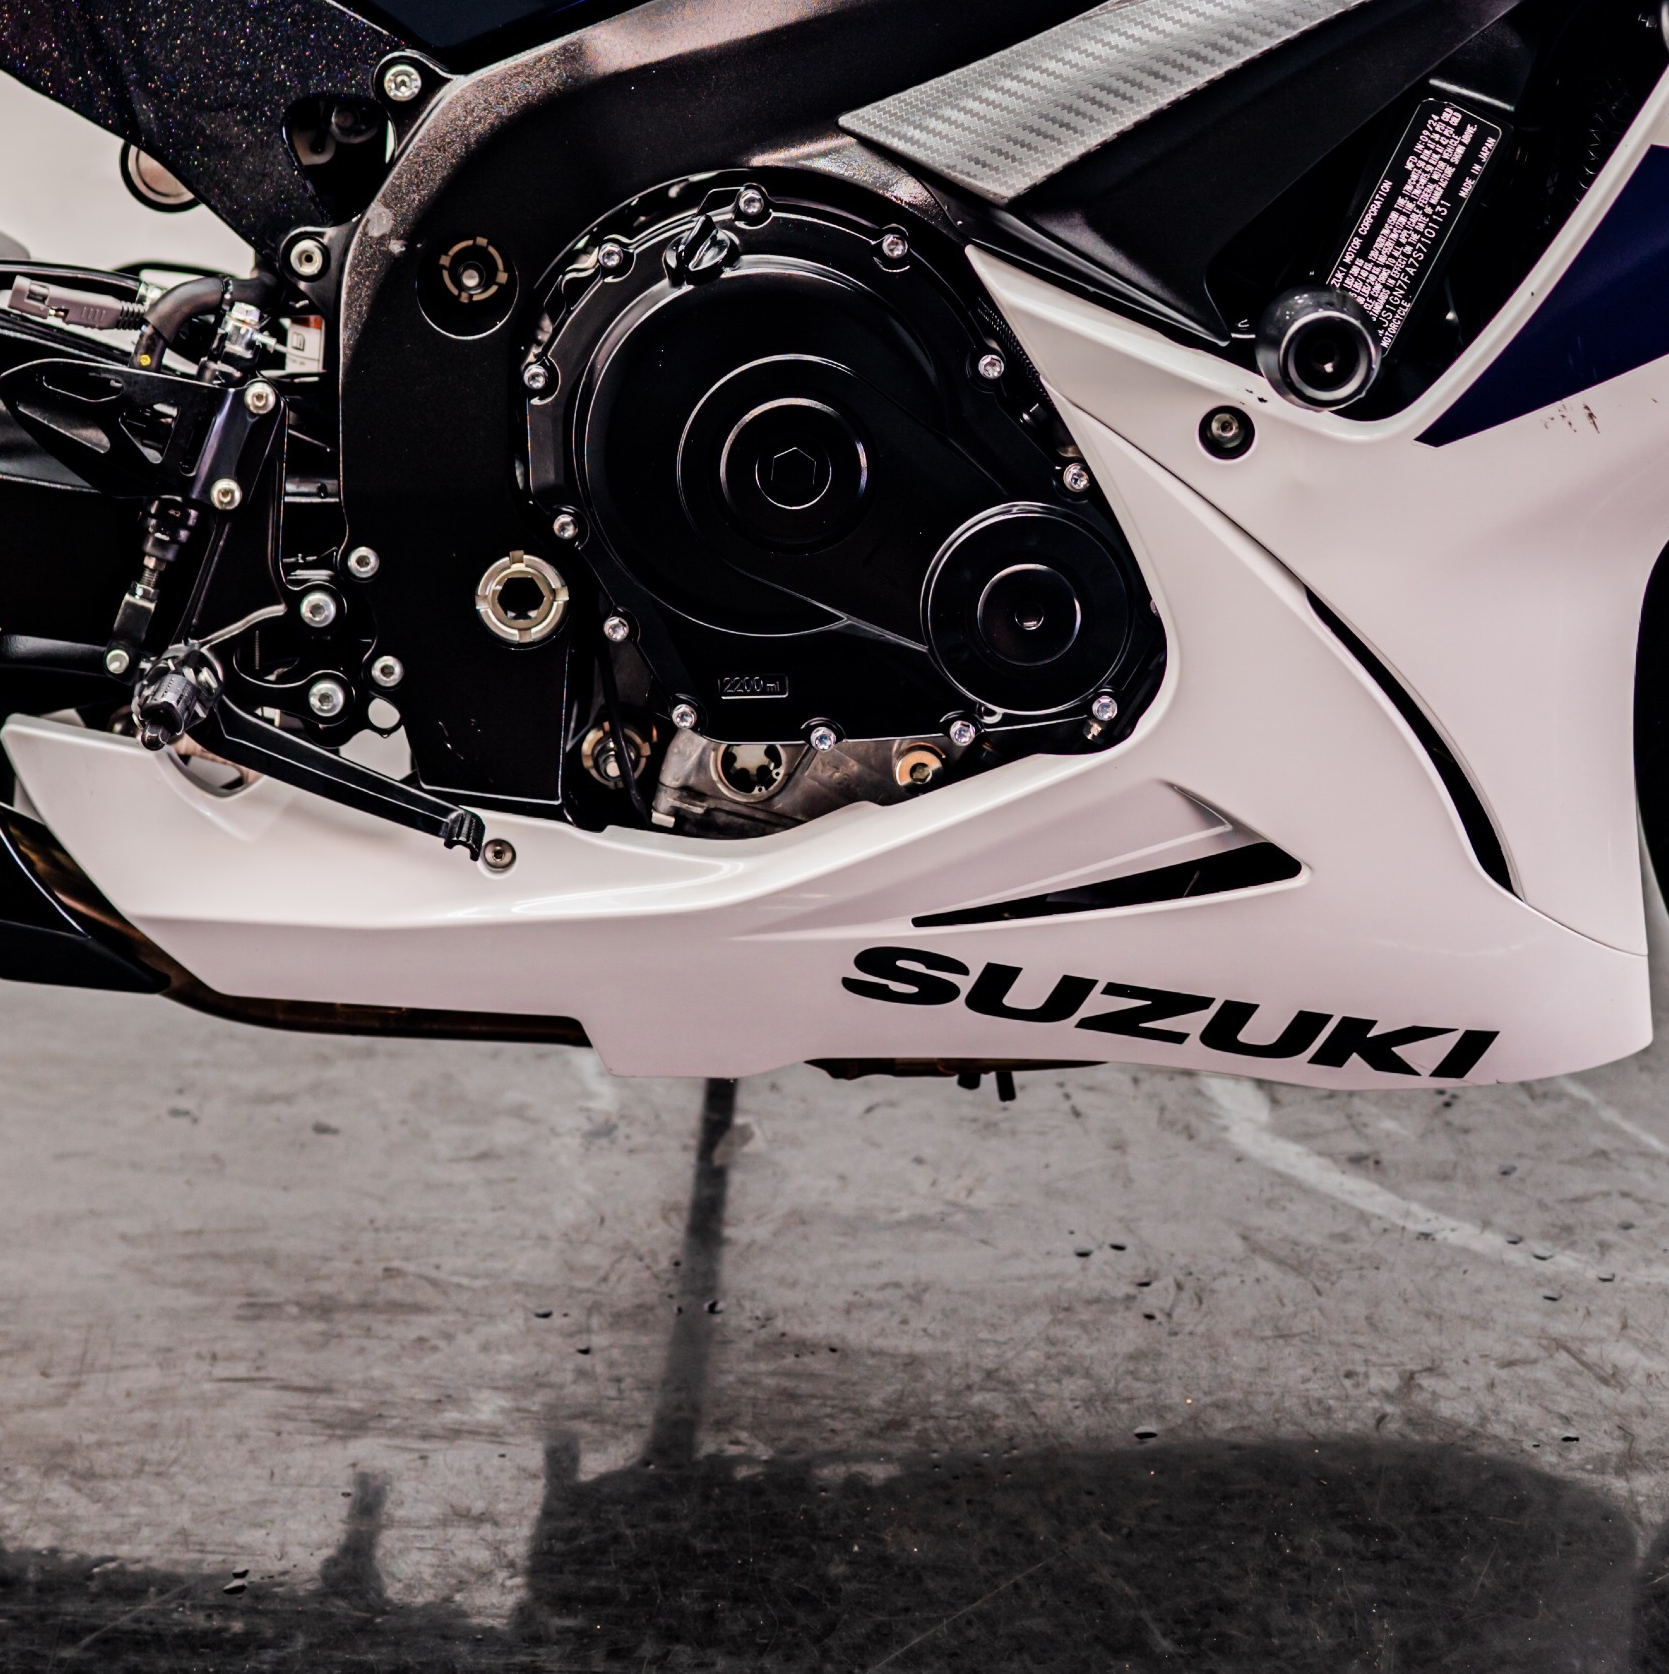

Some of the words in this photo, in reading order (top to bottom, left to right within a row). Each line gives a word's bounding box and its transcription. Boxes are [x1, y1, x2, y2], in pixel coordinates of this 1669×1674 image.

[1460, 124, 1477, 145] ABOVE.
[1404, 155, 1418, 171] MFD
[1450, 144, 1466, 165] SHOWN
[1458, 177, 1476, 199] MADE
[1470, 163, 1483, 176] IN
[1478, 137, 1498, 164] JAPAN
[1428, 164, 1456, 205] MANUFACTURE
[1370, 267, 1392, 297] CONFORMS
[1385, 257, 1397, 267] TO
[1391, 245, 1404, 258] ALL
[1398, 207, 1423, 244] APPLICABLE
[1416, 182, 1437, 208] FEDERAL
[1431, 160, 1448, 181] MOTOR
[1441, 133, 1463, 160] VEHICLE
[1424, 204, 1434, 215] OF
[1330, 266, 1347, 288] ZUKI
[1343, 237, 1363, 264] MOTOR
[1358, 180, 1393, 235] CORPORATION
[1414, 214, 1429, 232] DATE
[1408, 231, 1421, 244] THE
[1402, 244, 1414, 255] ON
[1379, 200, 1451, 327] JS1GN7FA7S7101131
[1390, 254, 1408, 278] EFFECT
[1380, 300, 1412, 348] MOTORCYCLE
[723, 677, 764, 692] 2200
[766, 681, 780, 692] ml
[841, 945, 1499, 1079] SUZUKI
